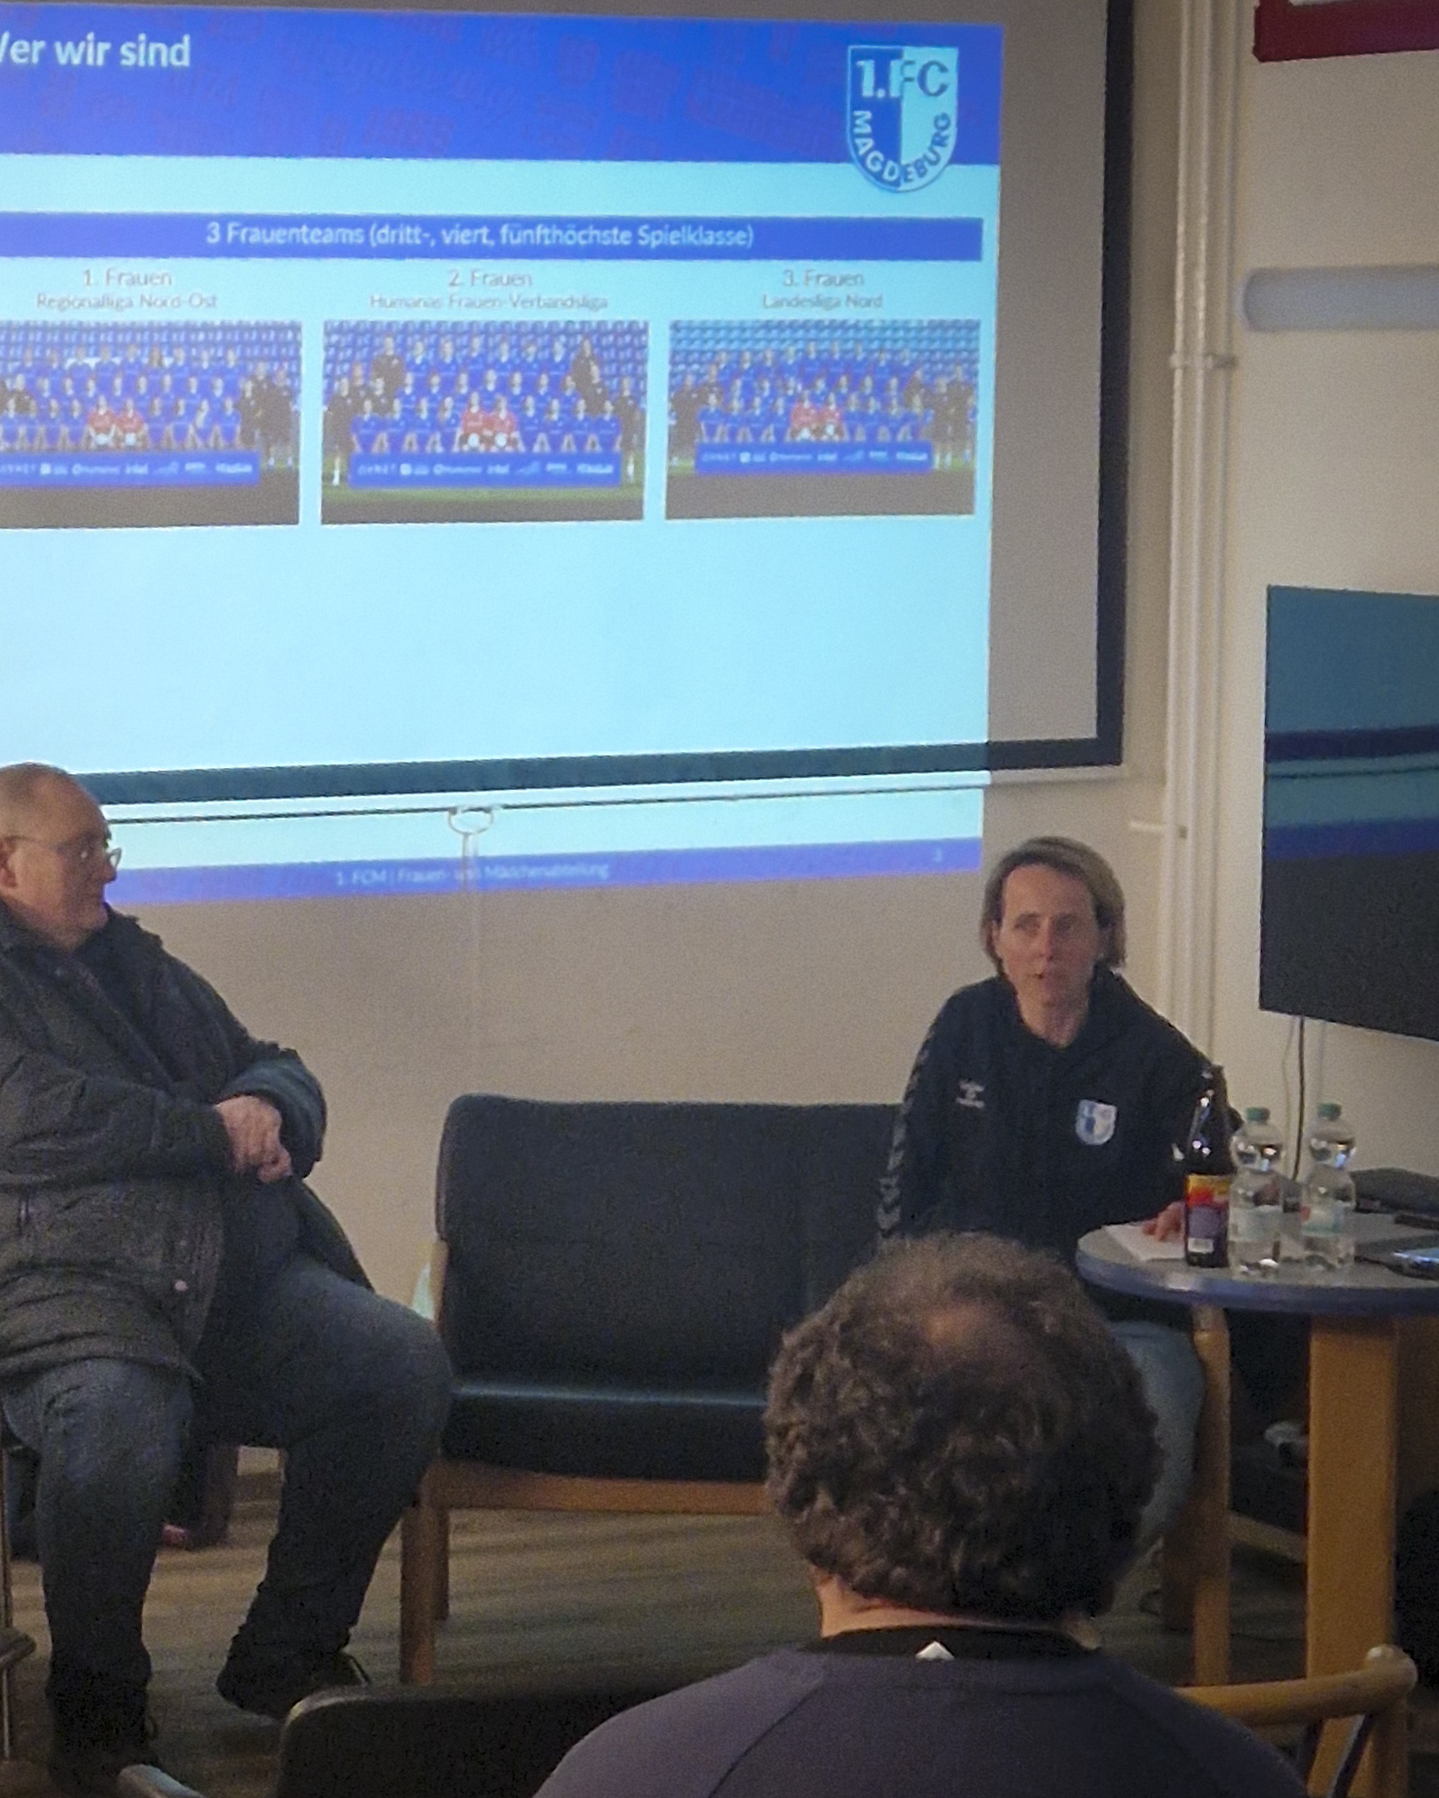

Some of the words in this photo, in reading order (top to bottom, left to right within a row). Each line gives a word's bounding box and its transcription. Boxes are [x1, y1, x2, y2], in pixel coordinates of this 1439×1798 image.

[54, 31, 111, 66] wir
[120, 33, 191, 68] sind
[853, 110, 951, 182] MAGDEBURG
[206, 221, 221, 245] 3
[227, 222, 363, 245] Frauenteams
[500, 223, 633, 246] fünfthöchste
[637, 224, 754, 249] Spielklasse)
[105, 268, 172, 286] Frauen
[470, 270, 532, 287] Frauen
[804, 270, 865, 287] Frauen
[763, 294, 841, 310] Landesliga
[847, 294, 883, 308] Nord
